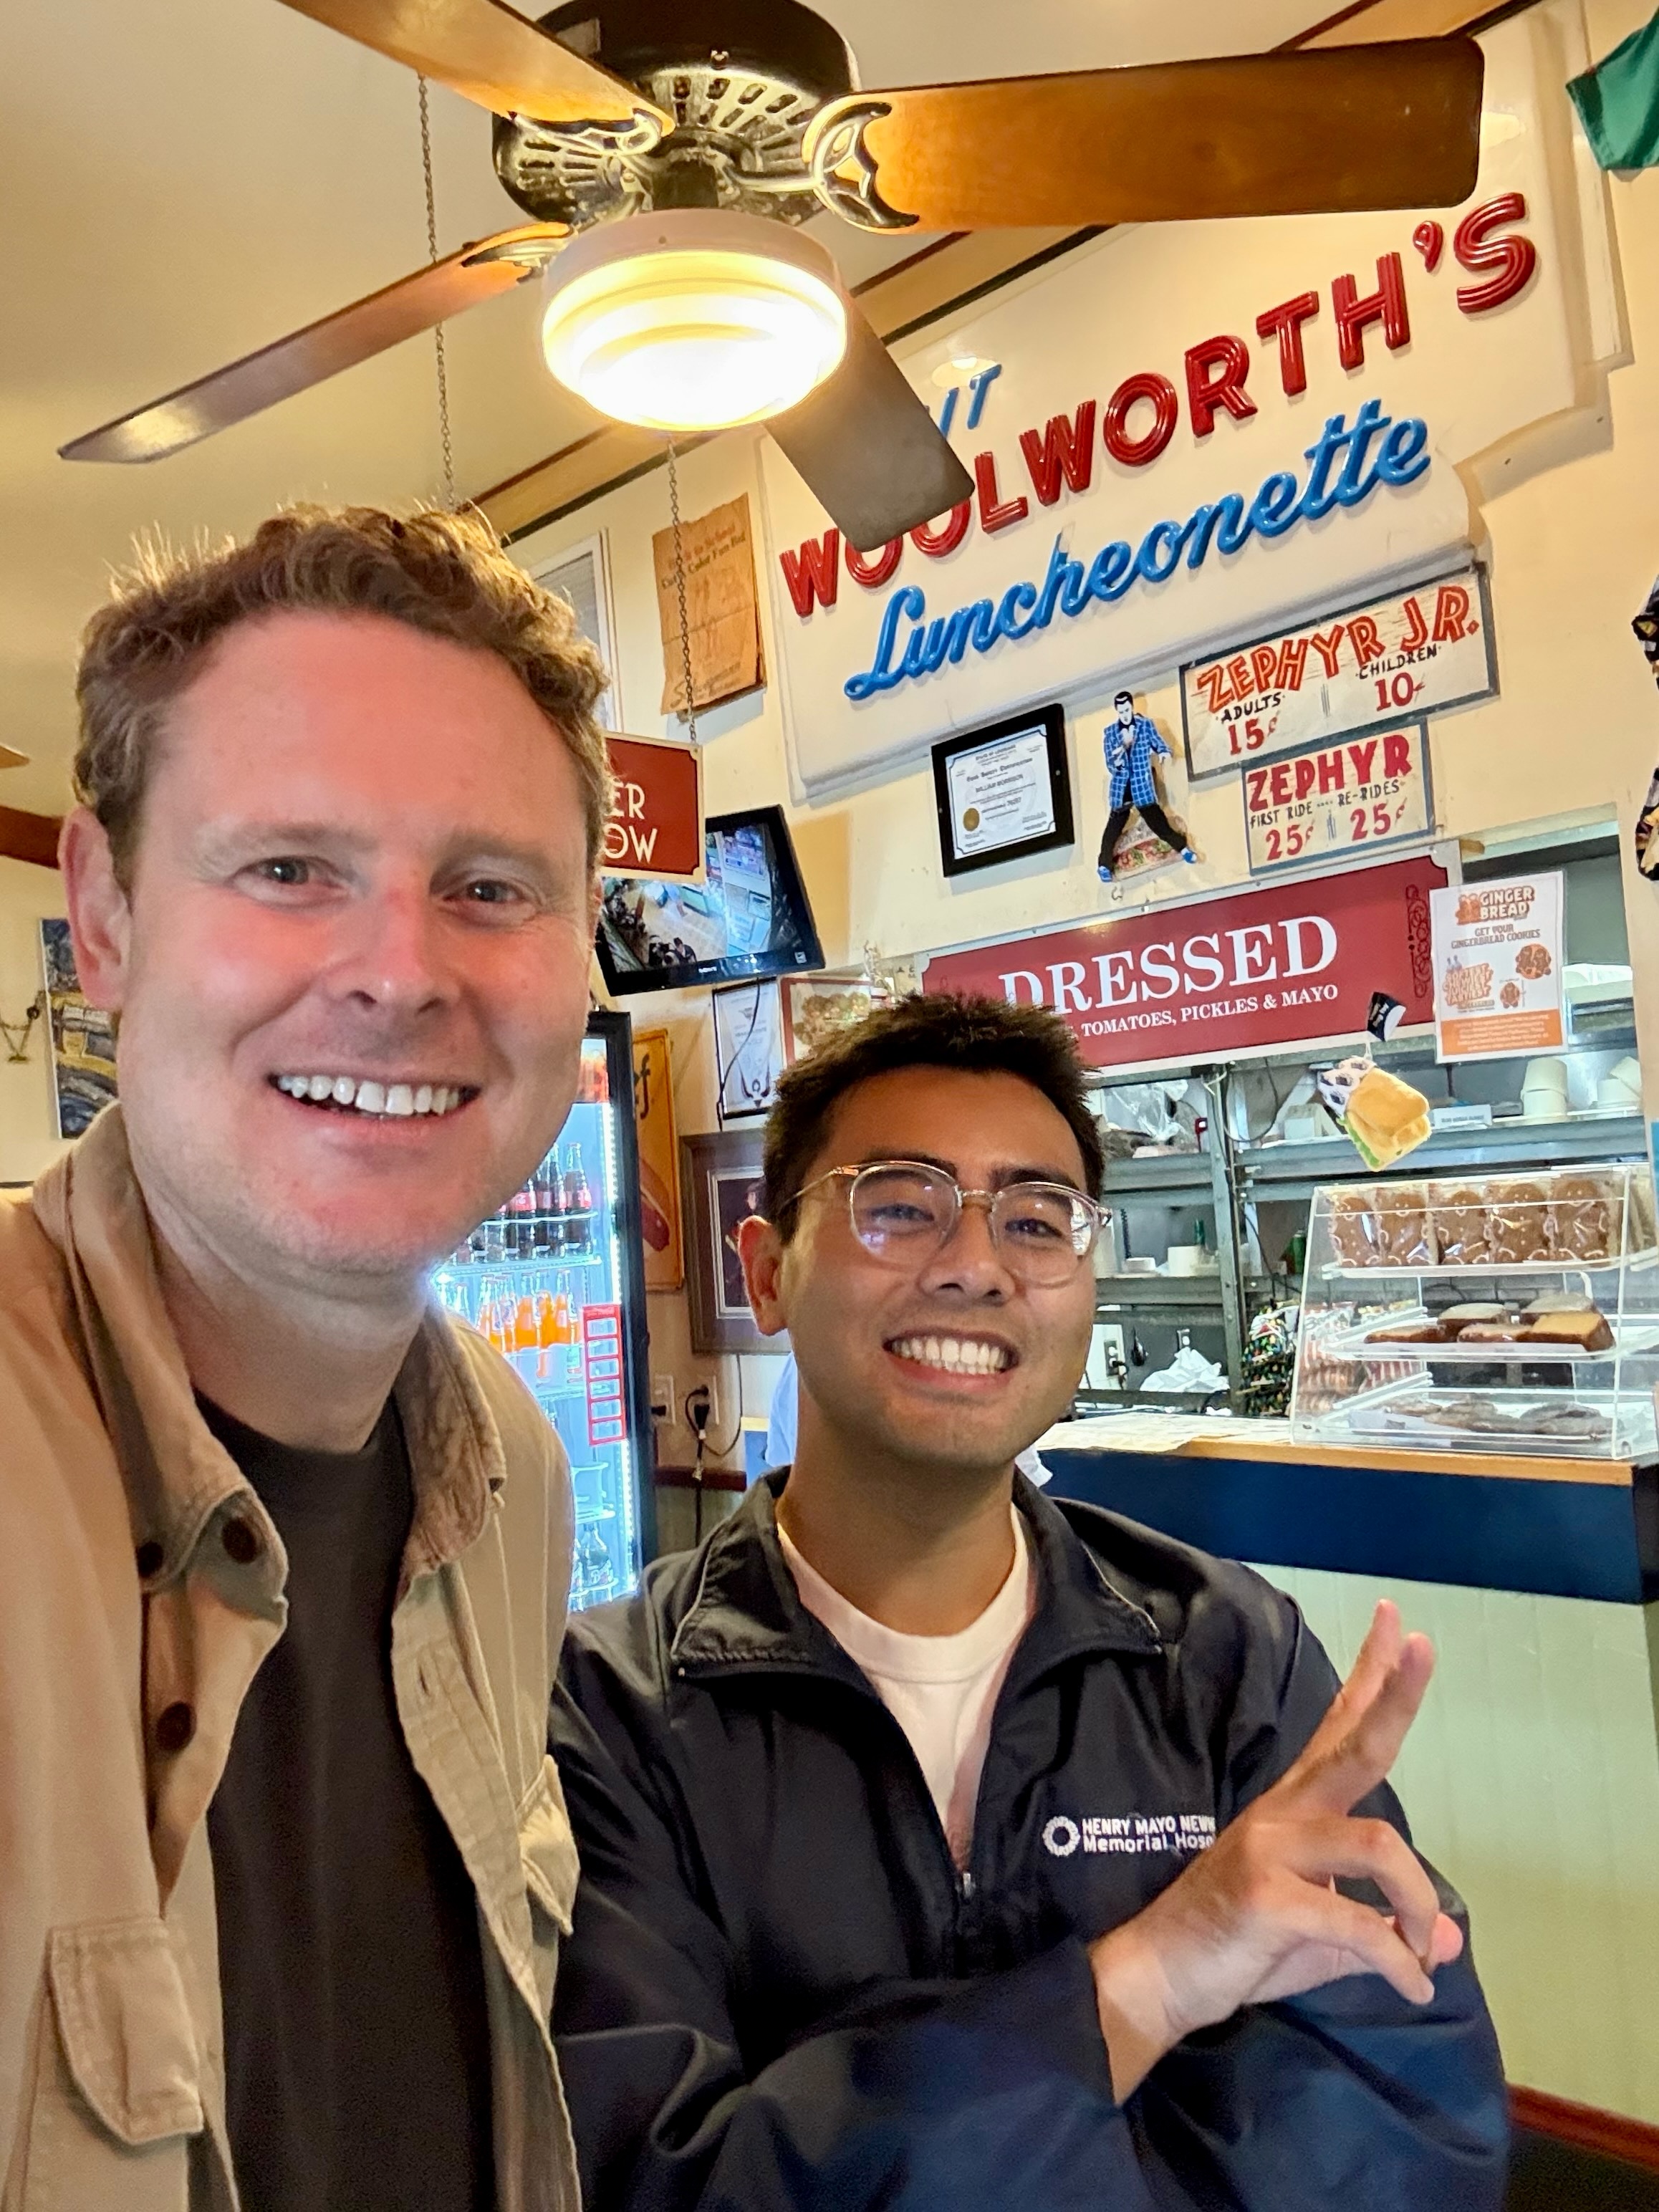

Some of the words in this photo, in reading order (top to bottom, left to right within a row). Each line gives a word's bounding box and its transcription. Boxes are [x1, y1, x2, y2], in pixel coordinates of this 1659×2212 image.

[924, 364, 1002, 439] IT
[844, 398, 1431, 700] Luncheonette
[1196, 615, 1386, 714] ZEPHYR
[1400, 586, 1480, 652] JR.
[1221, 692, 1282, 725] ADULTS
[1359, 643, 1438, 680] CHILDREN
[1246, 734, 1413, 813] ZEPHYR
[1249, 809, 1280, 830] FIRST
[1287, 801, 1313, 820] RIDE
[1479, 886, 1534, 906] GINGER
[1479, 902, 1529, 920] BREAD
[1474, 926, 1491, 937] GET
[998, 915, 1339, 1016] DRESSED
[1081, 1010, 1177, 1037] TOMATOES,
[1180, 996, 1259, 1023] PICKLES
[1262, 994, 1277, 1010] &
[1281, 984, 1339, 1008] MAYO
[1082, 1817, 1130, 1836] HENRY
[1135, 1815, 1176, 1834] MAYO
[1082, 1833, 1169, 1854] Memorial
